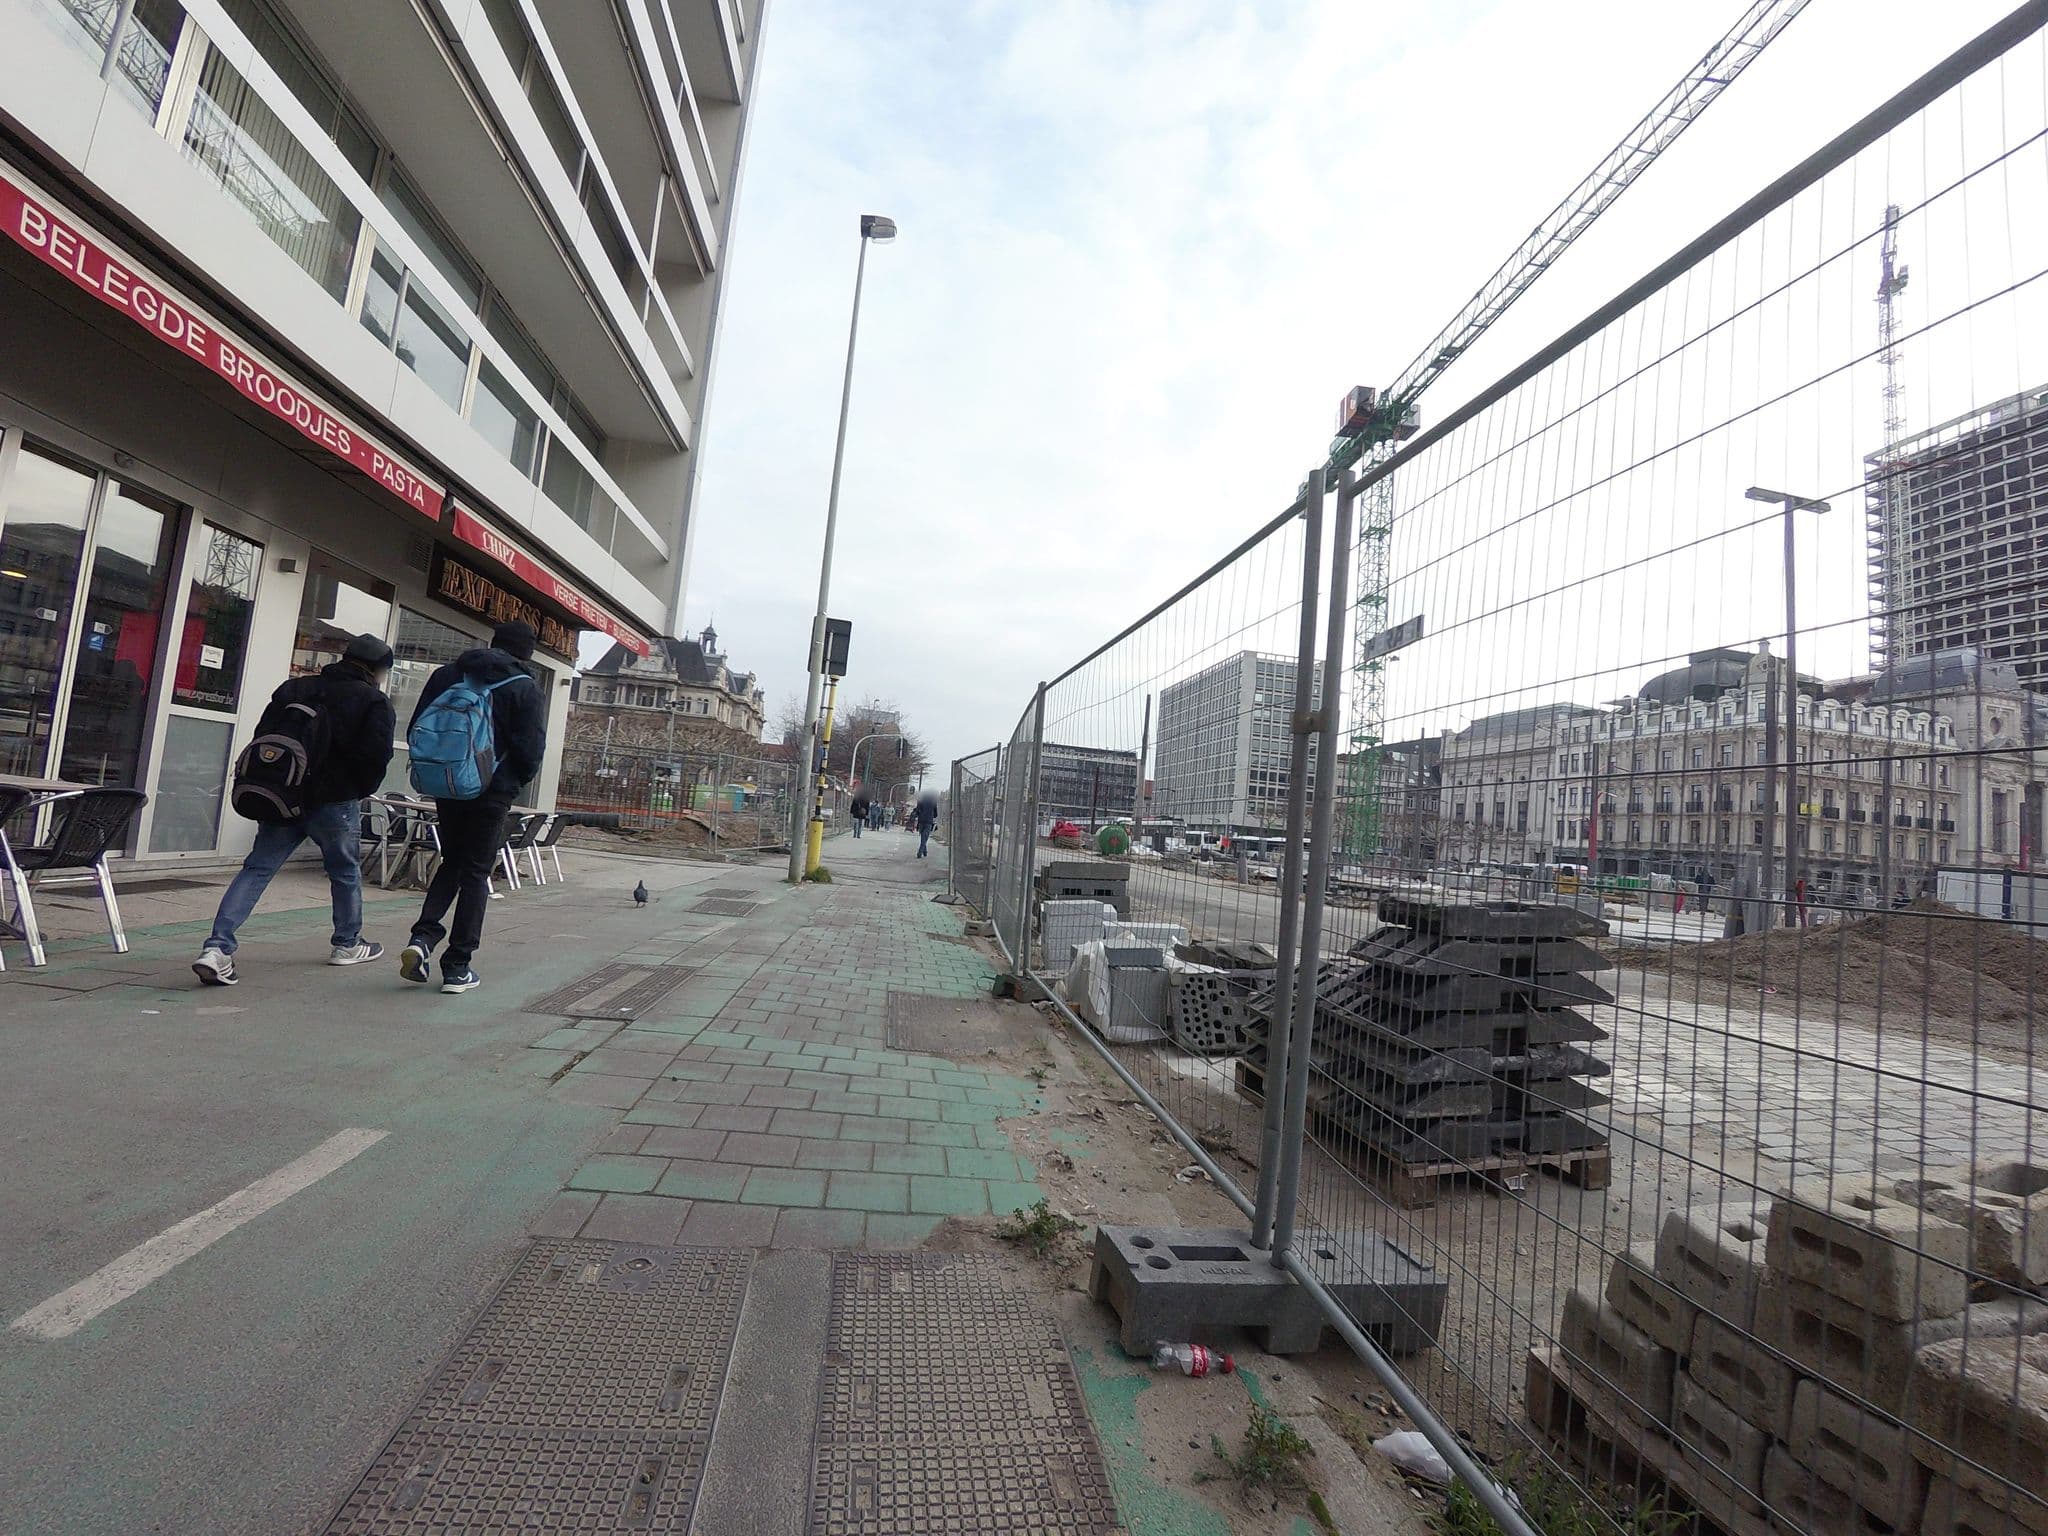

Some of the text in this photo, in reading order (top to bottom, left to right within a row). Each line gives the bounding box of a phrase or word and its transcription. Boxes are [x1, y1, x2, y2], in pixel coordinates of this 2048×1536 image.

[18, 201, 425, 507] BELEGDE BROODJES PASTA
[439, 560, 541, 637] EXPRESS
[553, 580, 578, 611] VERSE
